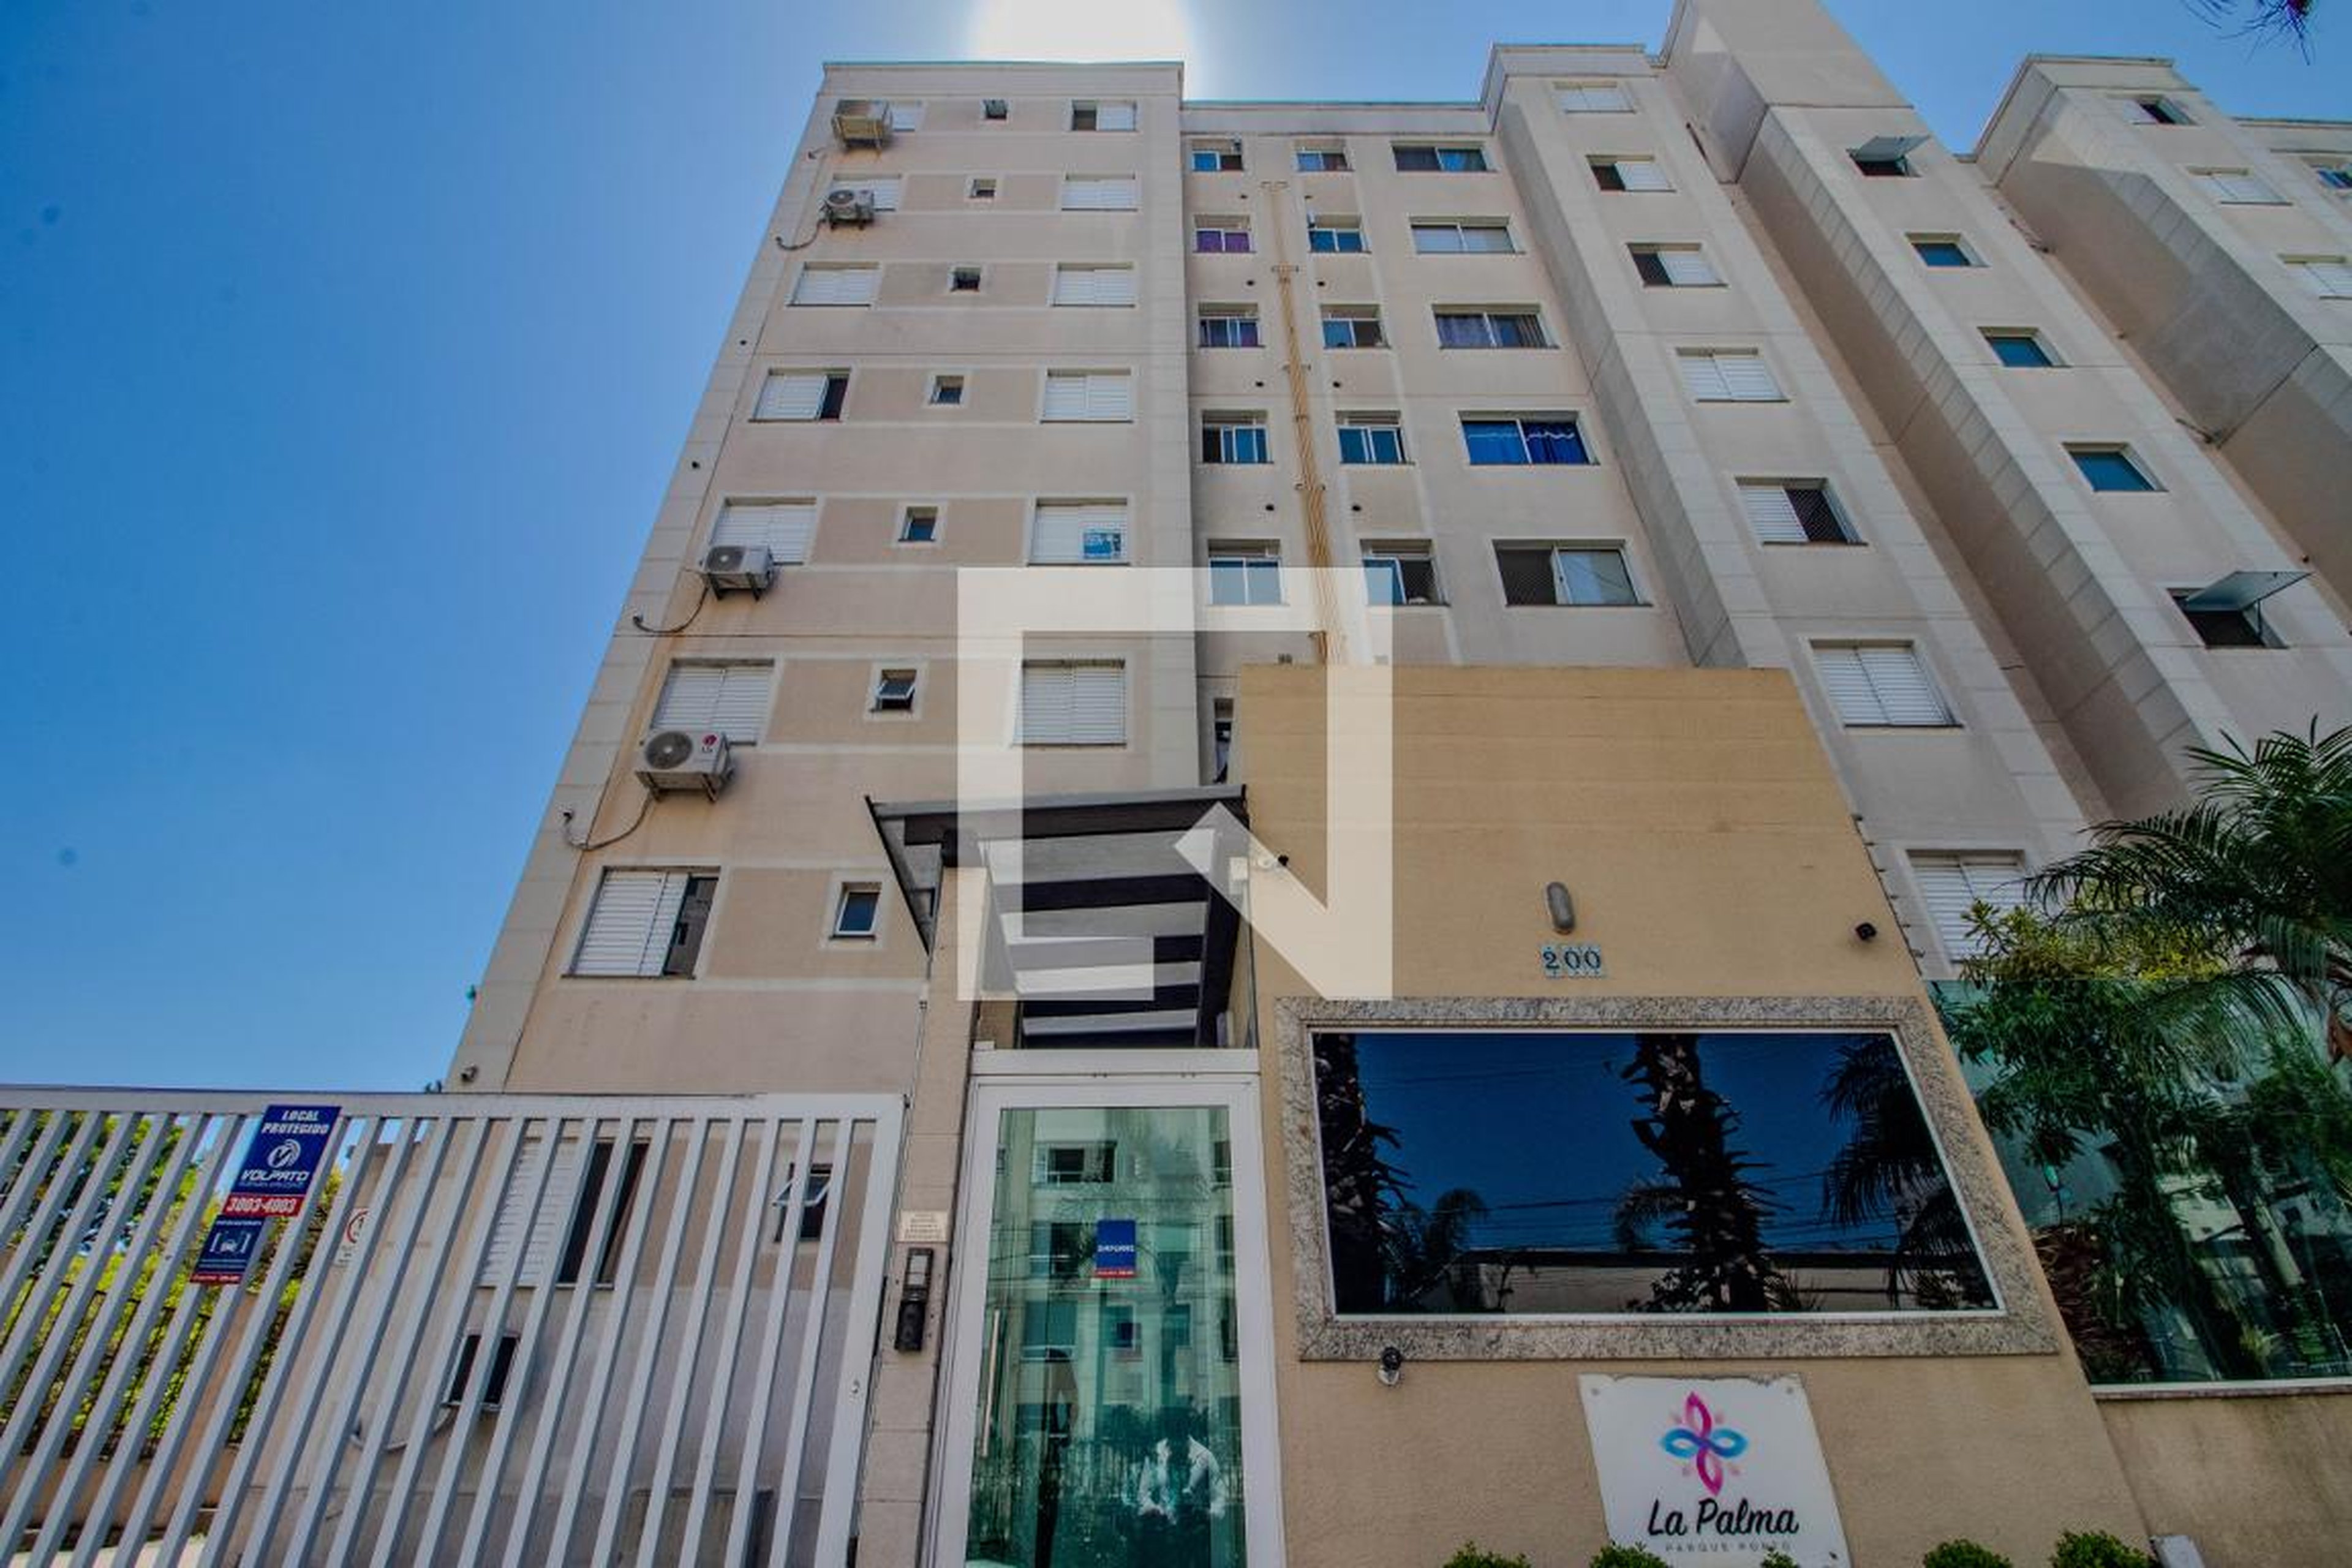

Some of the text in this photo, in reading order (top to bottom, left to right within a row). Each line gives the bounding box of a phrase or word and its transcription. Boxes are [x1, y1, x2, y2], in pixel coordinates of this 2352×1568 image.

[1543, 951, 1600, 970] 200
[281, 1110, 320, 1121] LOCAL
[261, 1122, 330, 1134] PROTEGIDO
[241, 1169, 310, 1181] VOLPATO
[1647, 1497, 1800, 1536] La Palma
